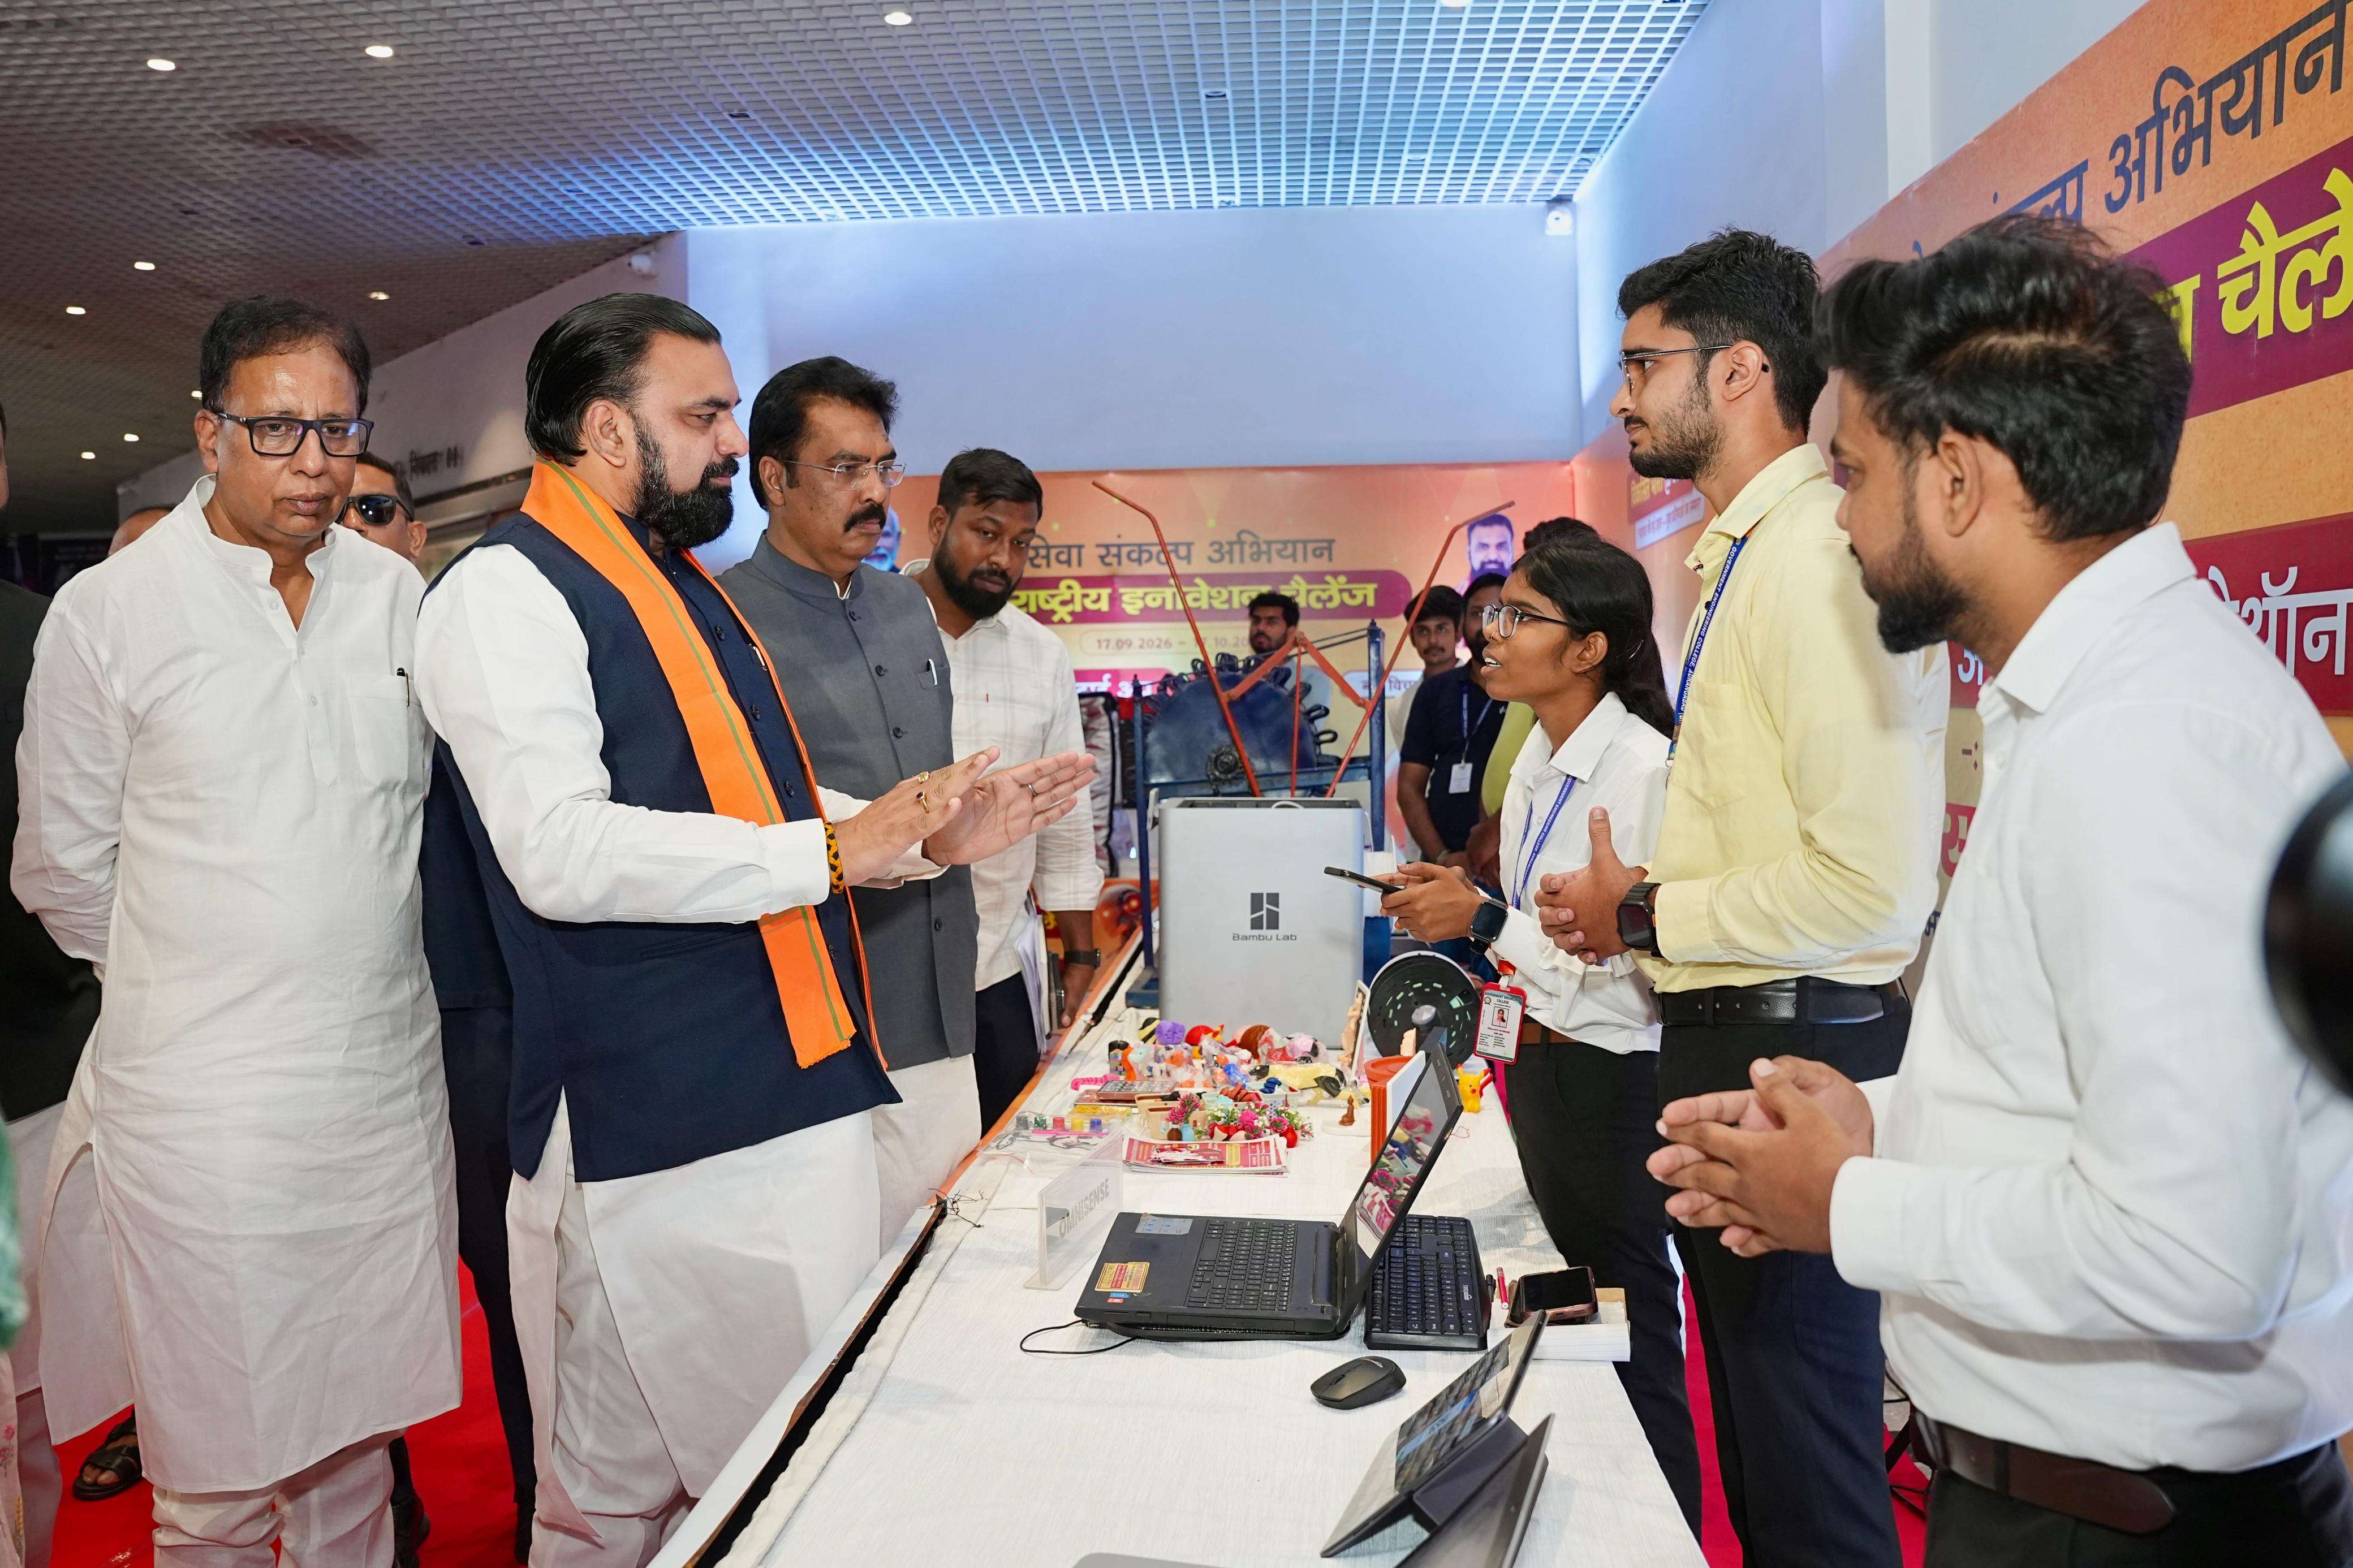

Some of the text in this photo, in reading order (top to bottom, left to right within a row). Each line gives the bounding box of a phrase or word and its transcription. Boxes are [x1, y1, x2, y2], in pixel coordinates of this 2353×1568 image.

[2104, 0, 2353, 214] अभियान
[1096, 534, 1195, 567] संकल्प
[1208, 530, 1335, 564] अभियान
[1718, 546, 1738, 593] GOVERNMENT
[1700, 592, 1720, 637] ENGINEERING
[1096, 637, 1172, 650] 17.09.2026
[1689, 637, 1703, 668] COLLEGE,
[1542, 803, 1561, 833] ENGINEERING
[1059, 1177, 1109, 1238] OMNISENSE
